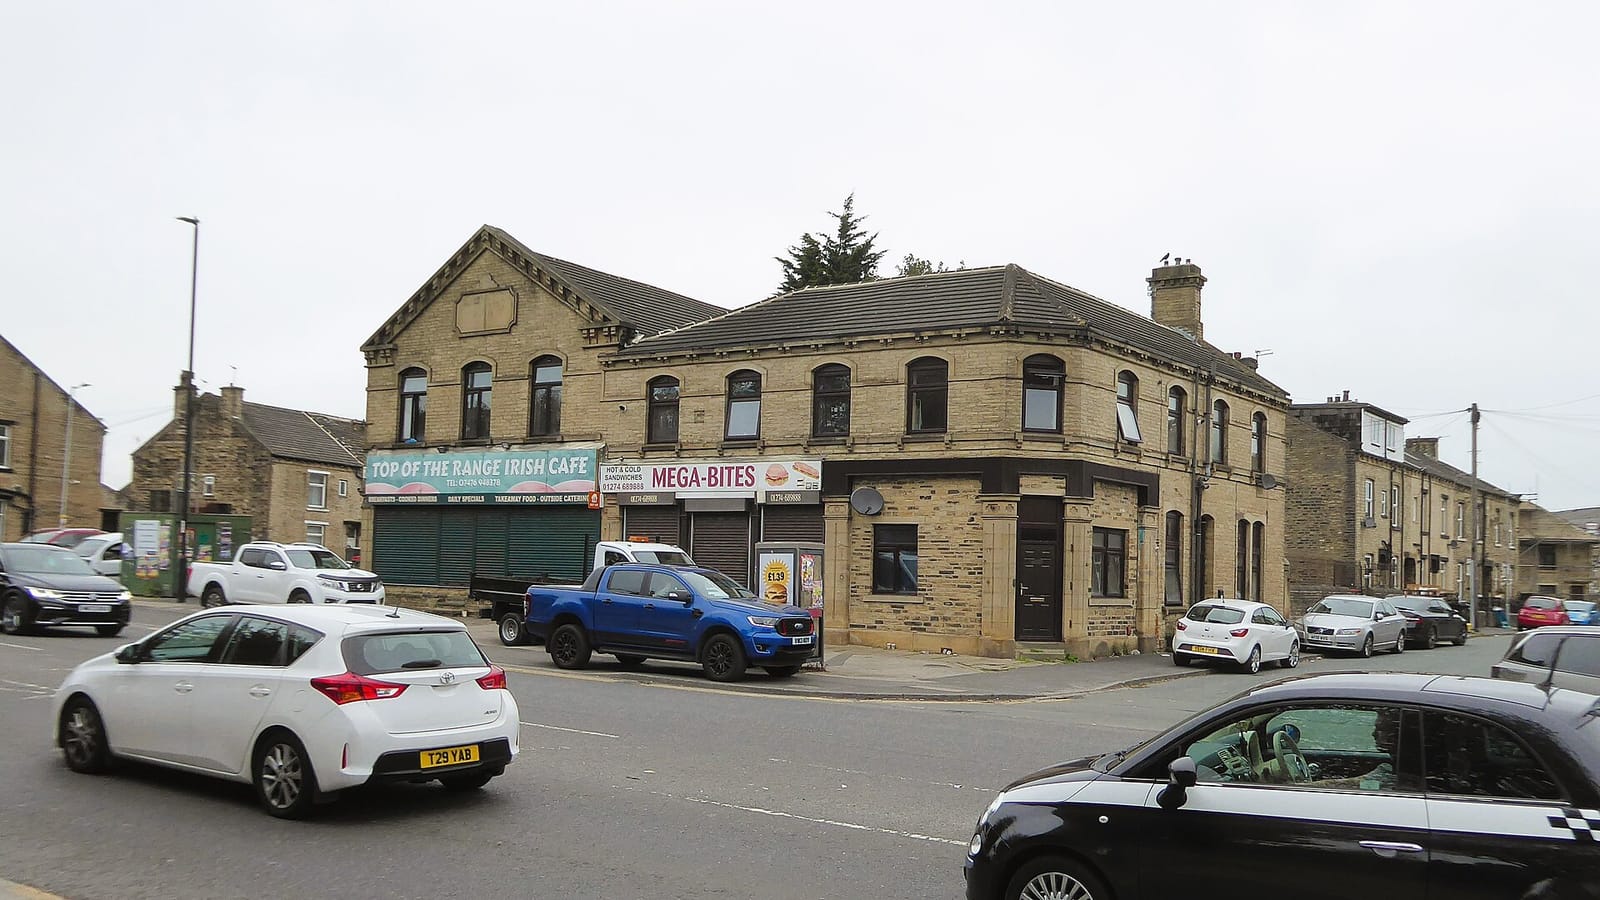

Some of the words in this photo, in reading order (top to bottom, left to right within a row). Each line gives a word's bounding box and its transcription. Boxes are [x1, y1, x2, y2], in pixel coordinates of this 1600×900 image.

[372, 461, 399, 478] TOP
[401, 460, 420, 477] OF
[423, 460, 449, 477] THE
[452, 458, 500, 477] RANGE
[504, 458, 546, 476] IRISH
[548, 456, 588, 474] CAFE
[652, 465, 755, 488] MEGA-BITES
[768, 571, 785, 581] £1.39
[428, 751, 449, 765] T29
[451, 748, 472, 762] YAB
